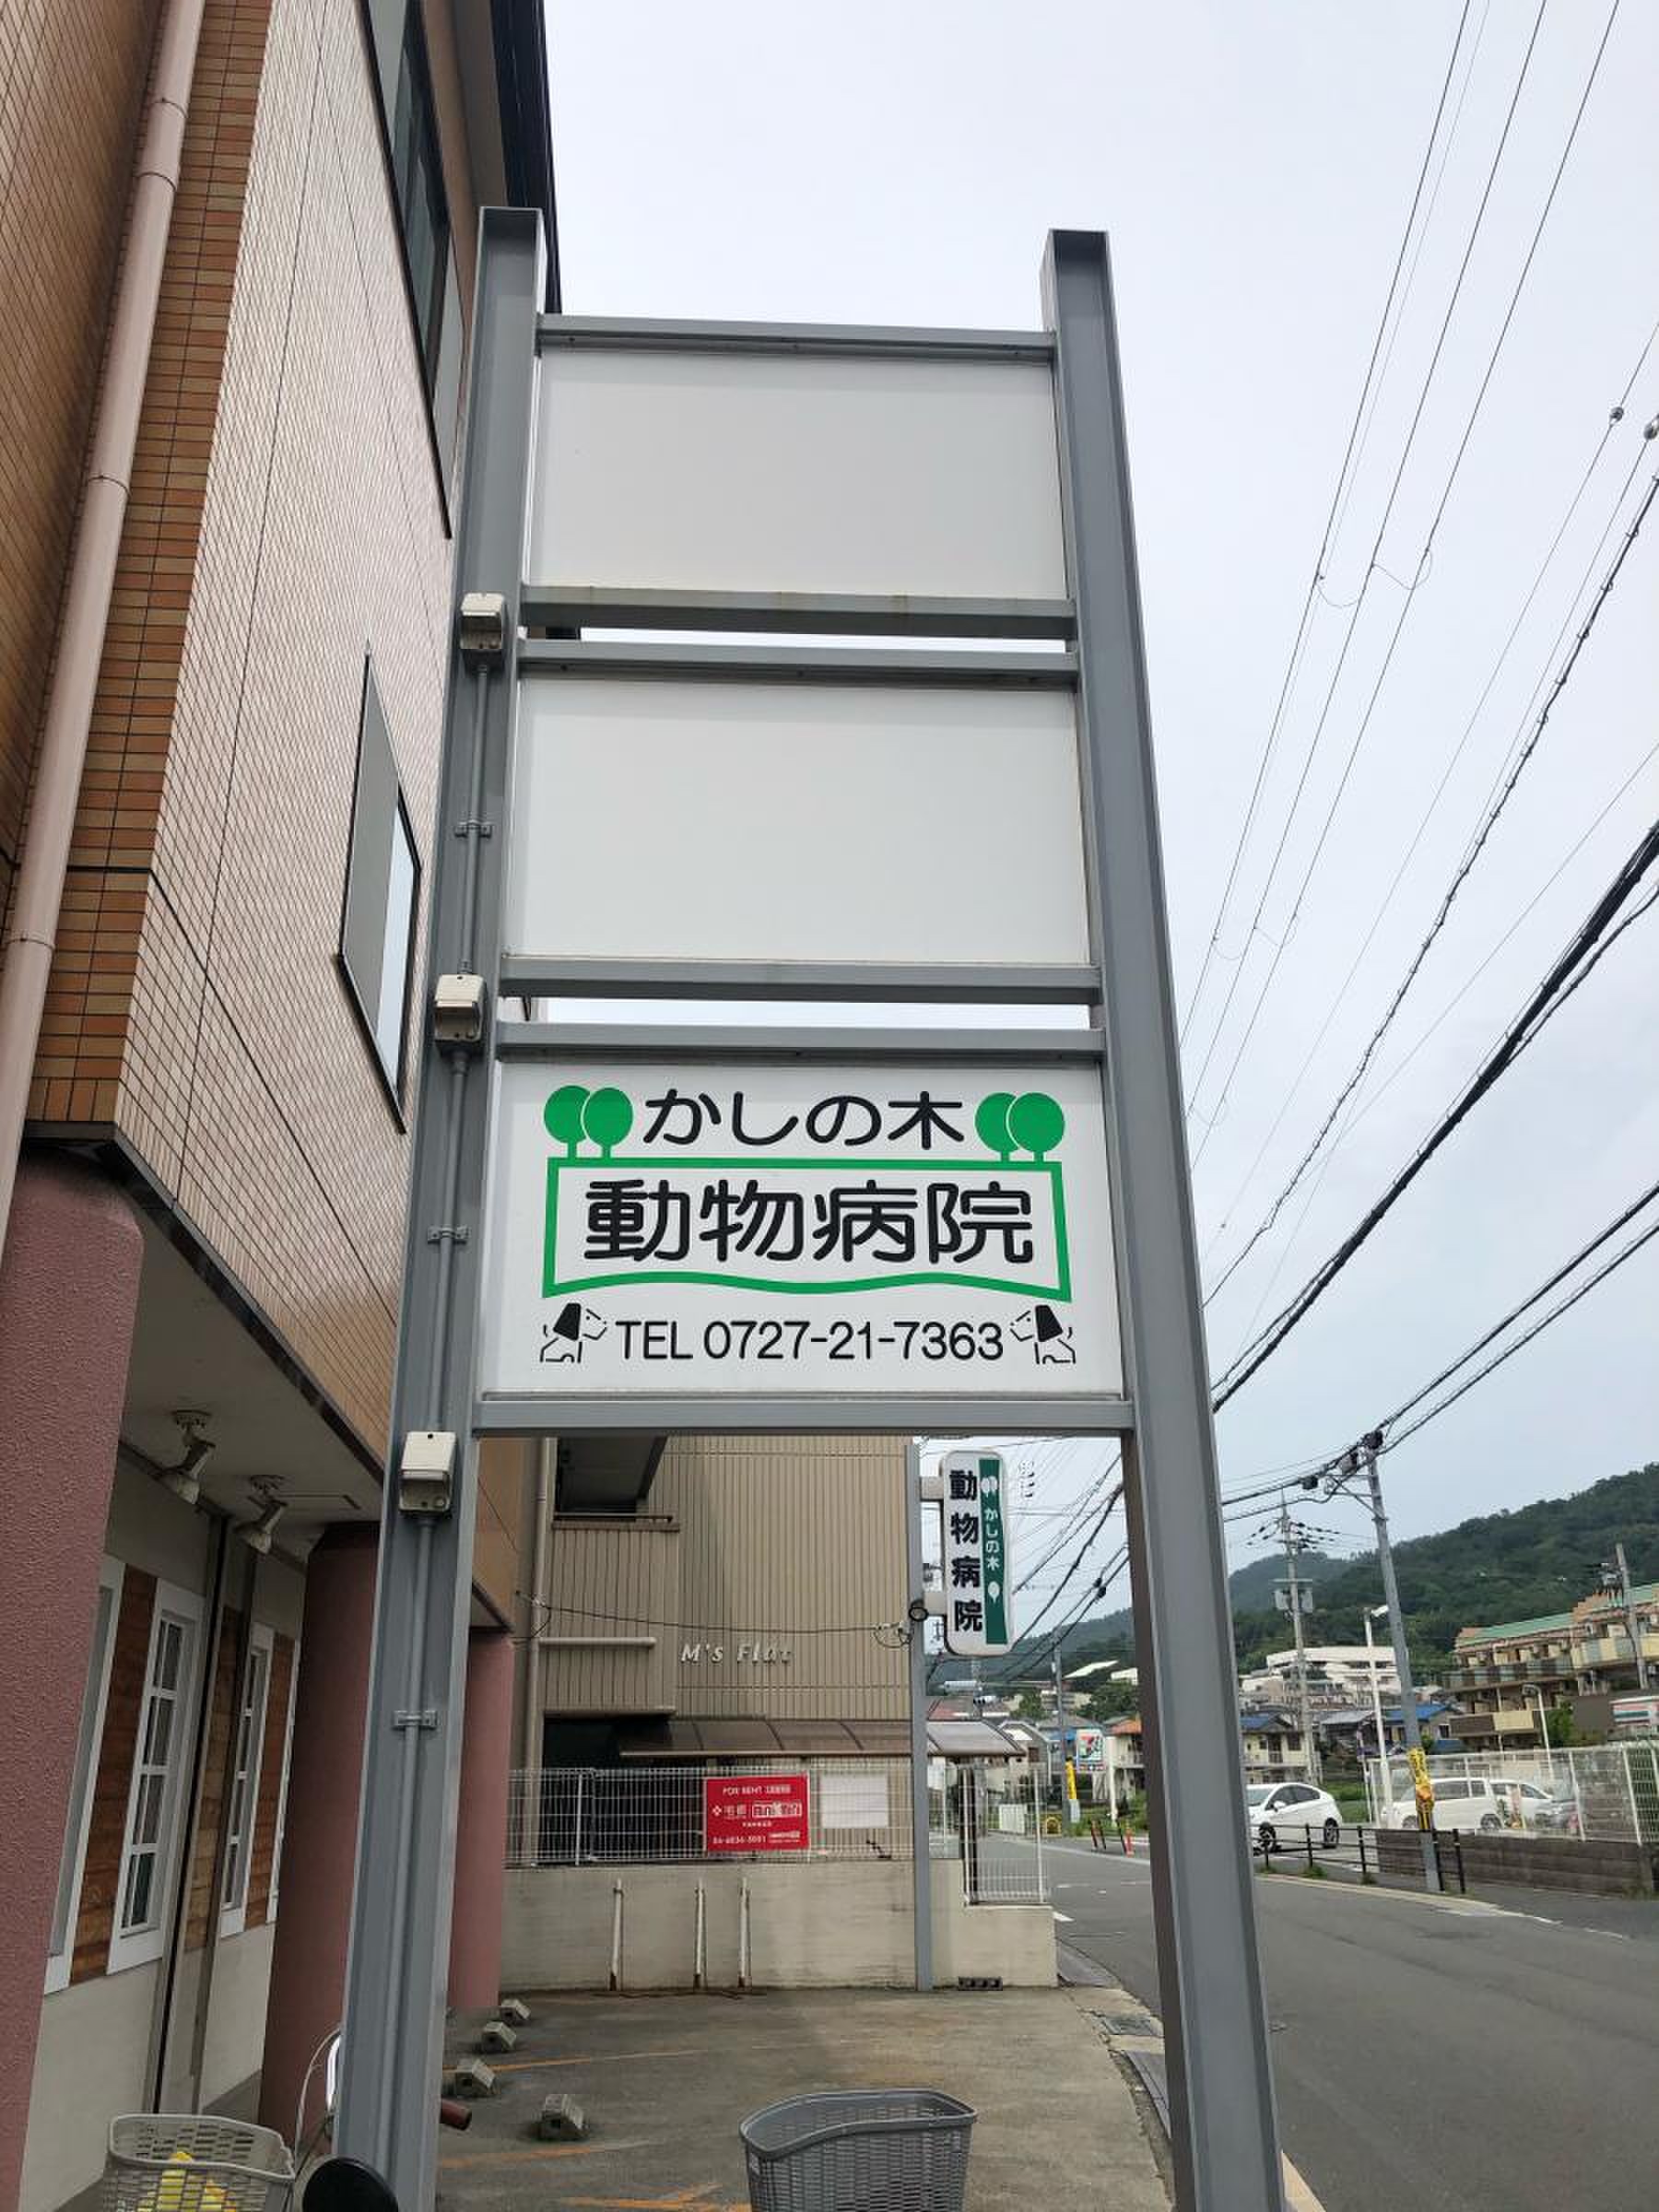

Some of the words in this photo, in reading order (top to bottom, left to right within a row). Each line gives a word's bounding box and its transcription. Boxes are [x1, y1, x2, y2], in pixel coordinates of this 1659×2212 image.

[643, 1088, 964, 1150] かしの木
[583, 1179, 1033, 1264] 動物病院
[616, 1321, 693, 1359] TEL
[703, 1321, 1004, 1361] 0727-21-7363
[949, 1469, 983, 1632] 動物病院
[984, 1507, 1001, 1571] かしの木
[680, 1643, 724, 1664] M's
